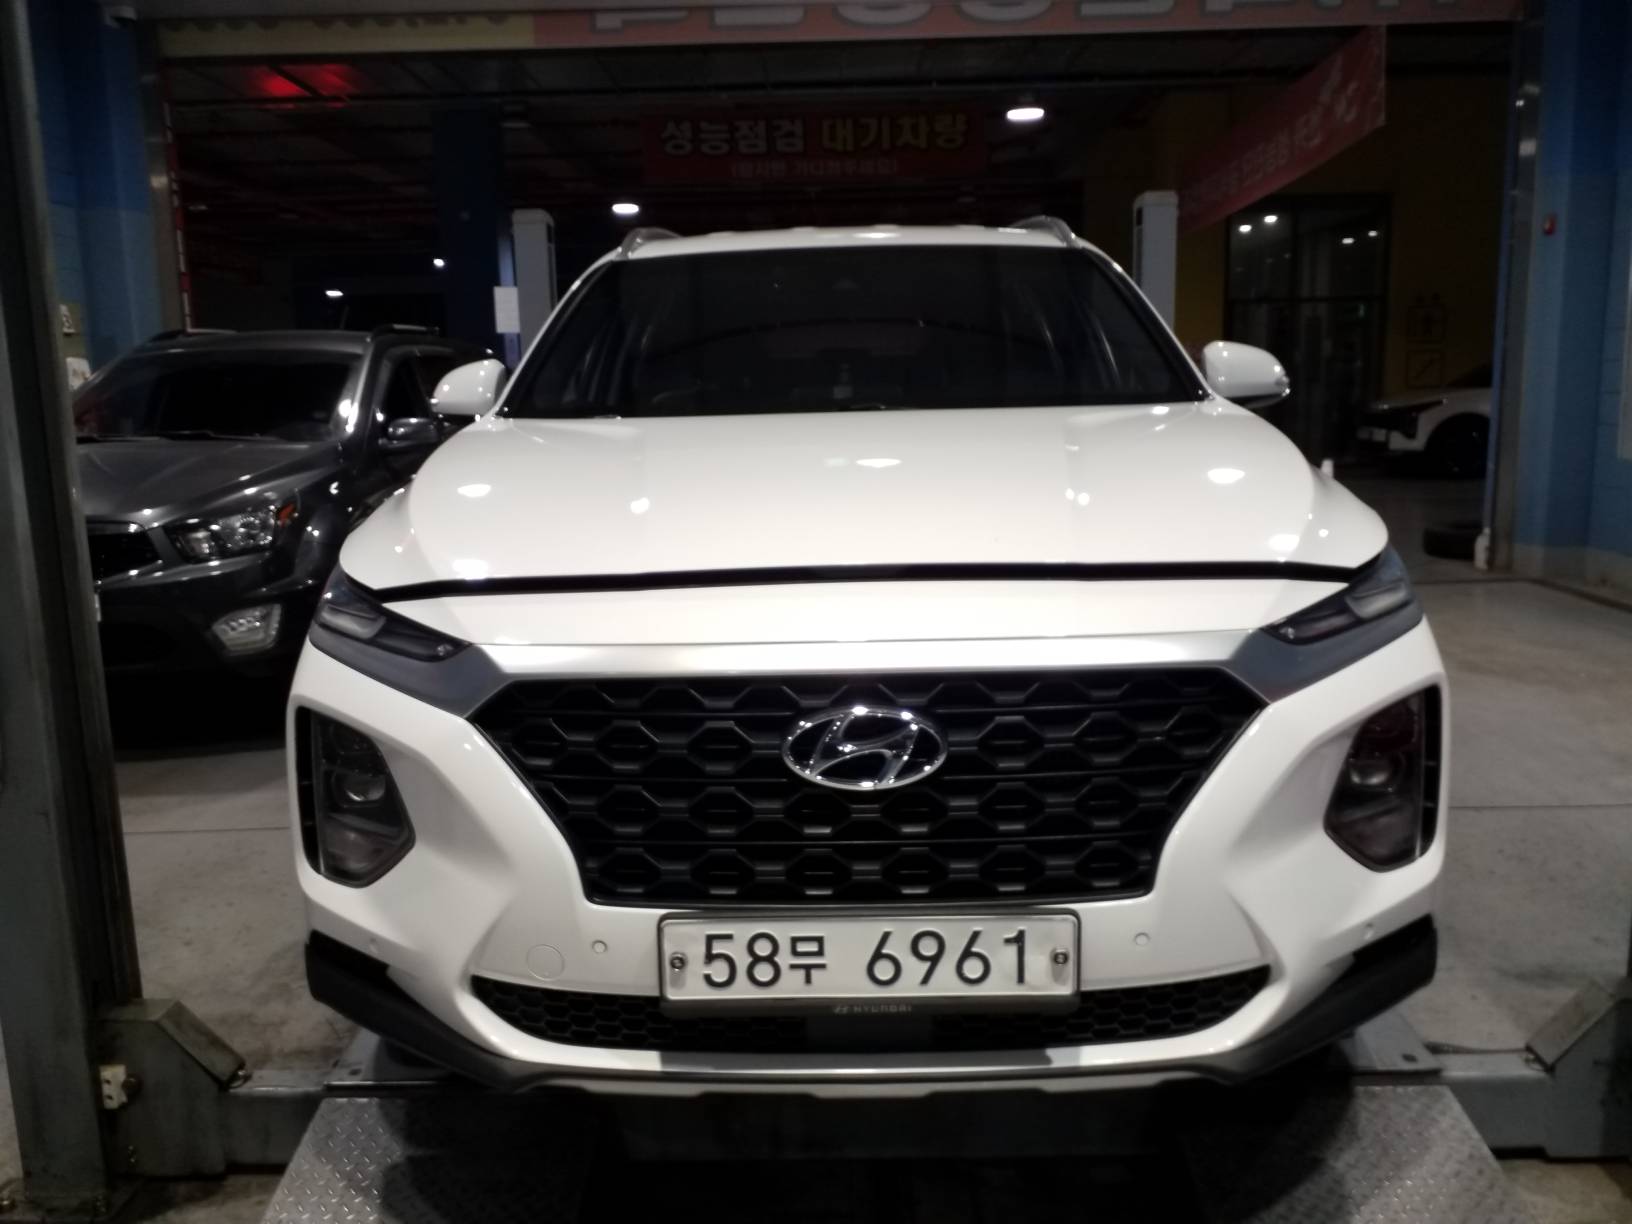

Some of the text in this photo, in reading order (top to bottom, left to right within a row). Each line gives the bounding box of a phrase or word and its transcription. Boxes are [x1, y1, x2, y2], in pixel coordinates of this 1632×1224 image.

[660, 113, 968, 155] 성능점검 대기차량
[702, 928, 1028, 988] 58무 6961
[853, 1004, 912, 1014] HYUNDAI
